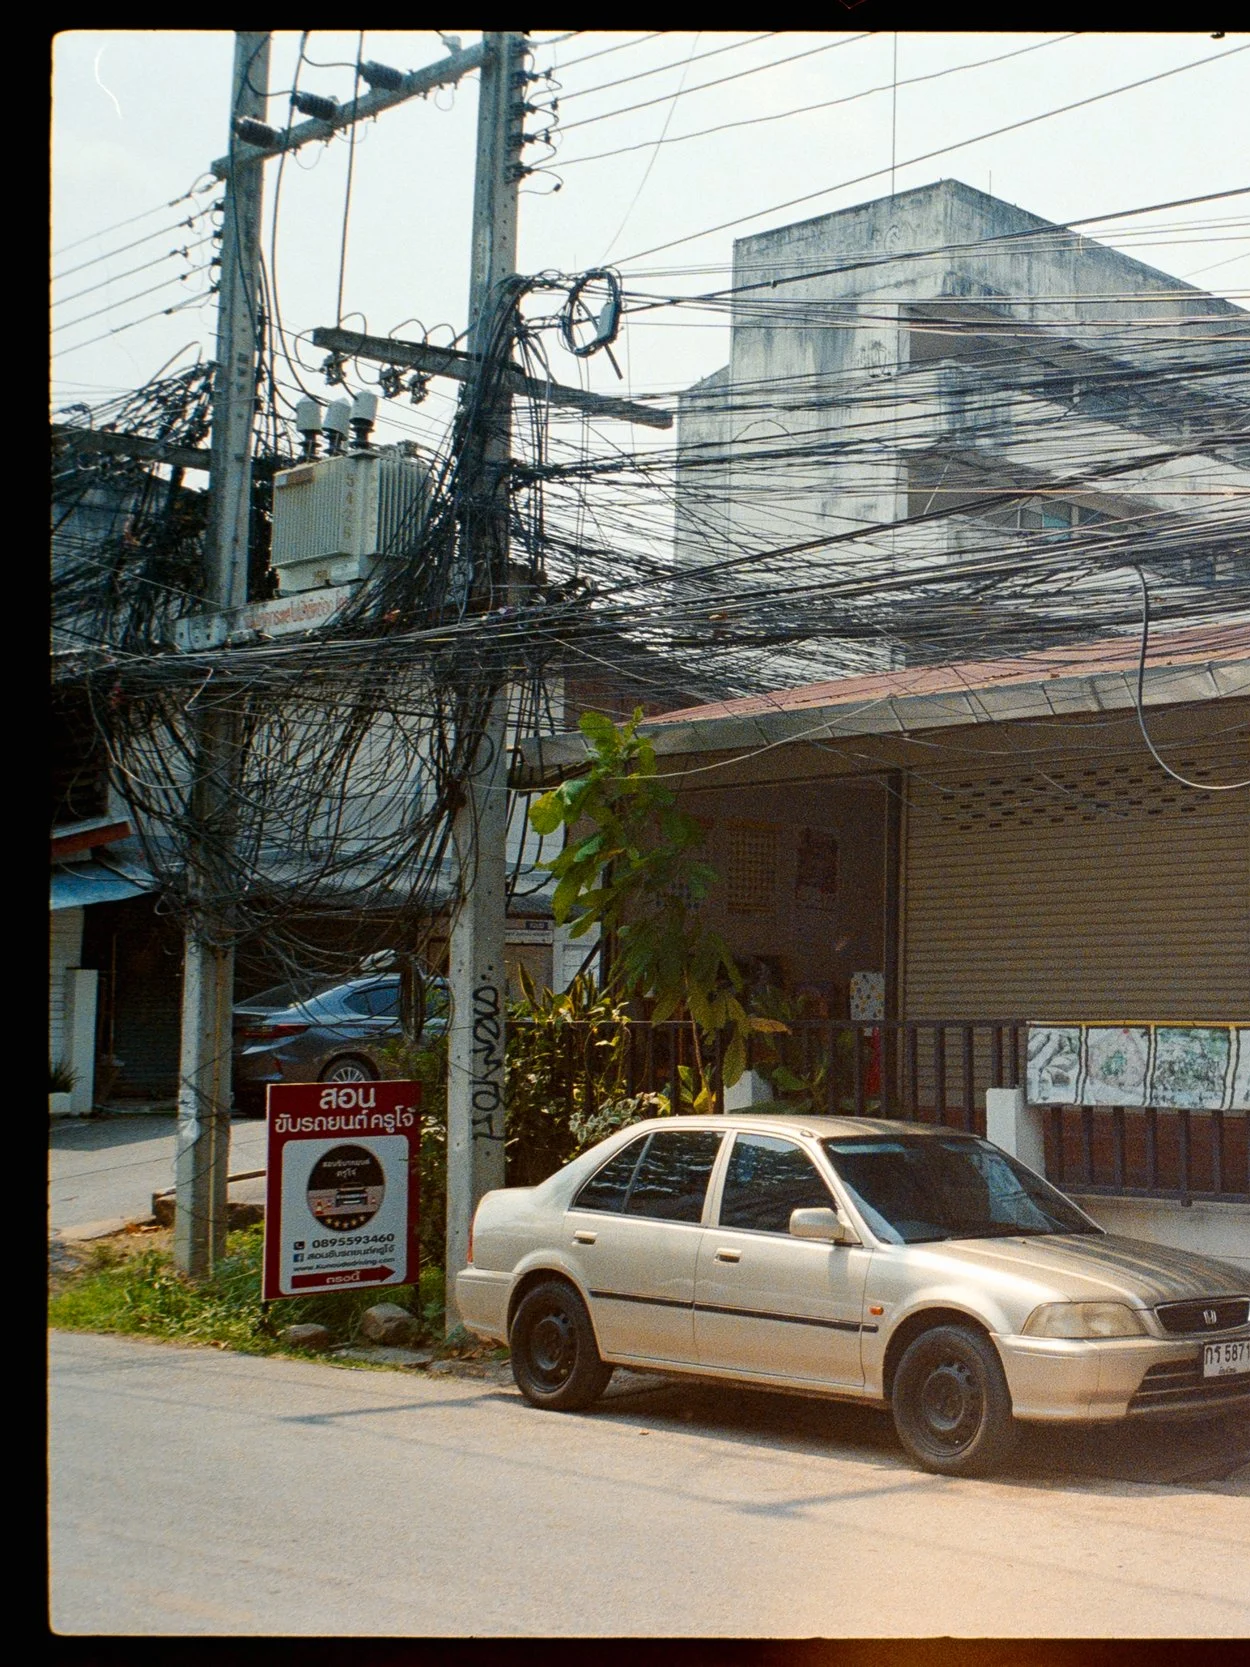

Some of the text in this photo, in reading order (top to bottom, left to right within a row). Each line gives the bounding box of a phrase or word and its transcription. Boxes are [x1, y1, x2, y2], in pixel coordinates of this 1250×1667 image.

[319, 1087, 376, 1109] สอน
[275, 1105, 416, 1133] ขับรถยนต์ ครูโจ้
[312, 1233, 395, 1249] 0895593460
[1225, 1343, 1250, 1362] 5871
